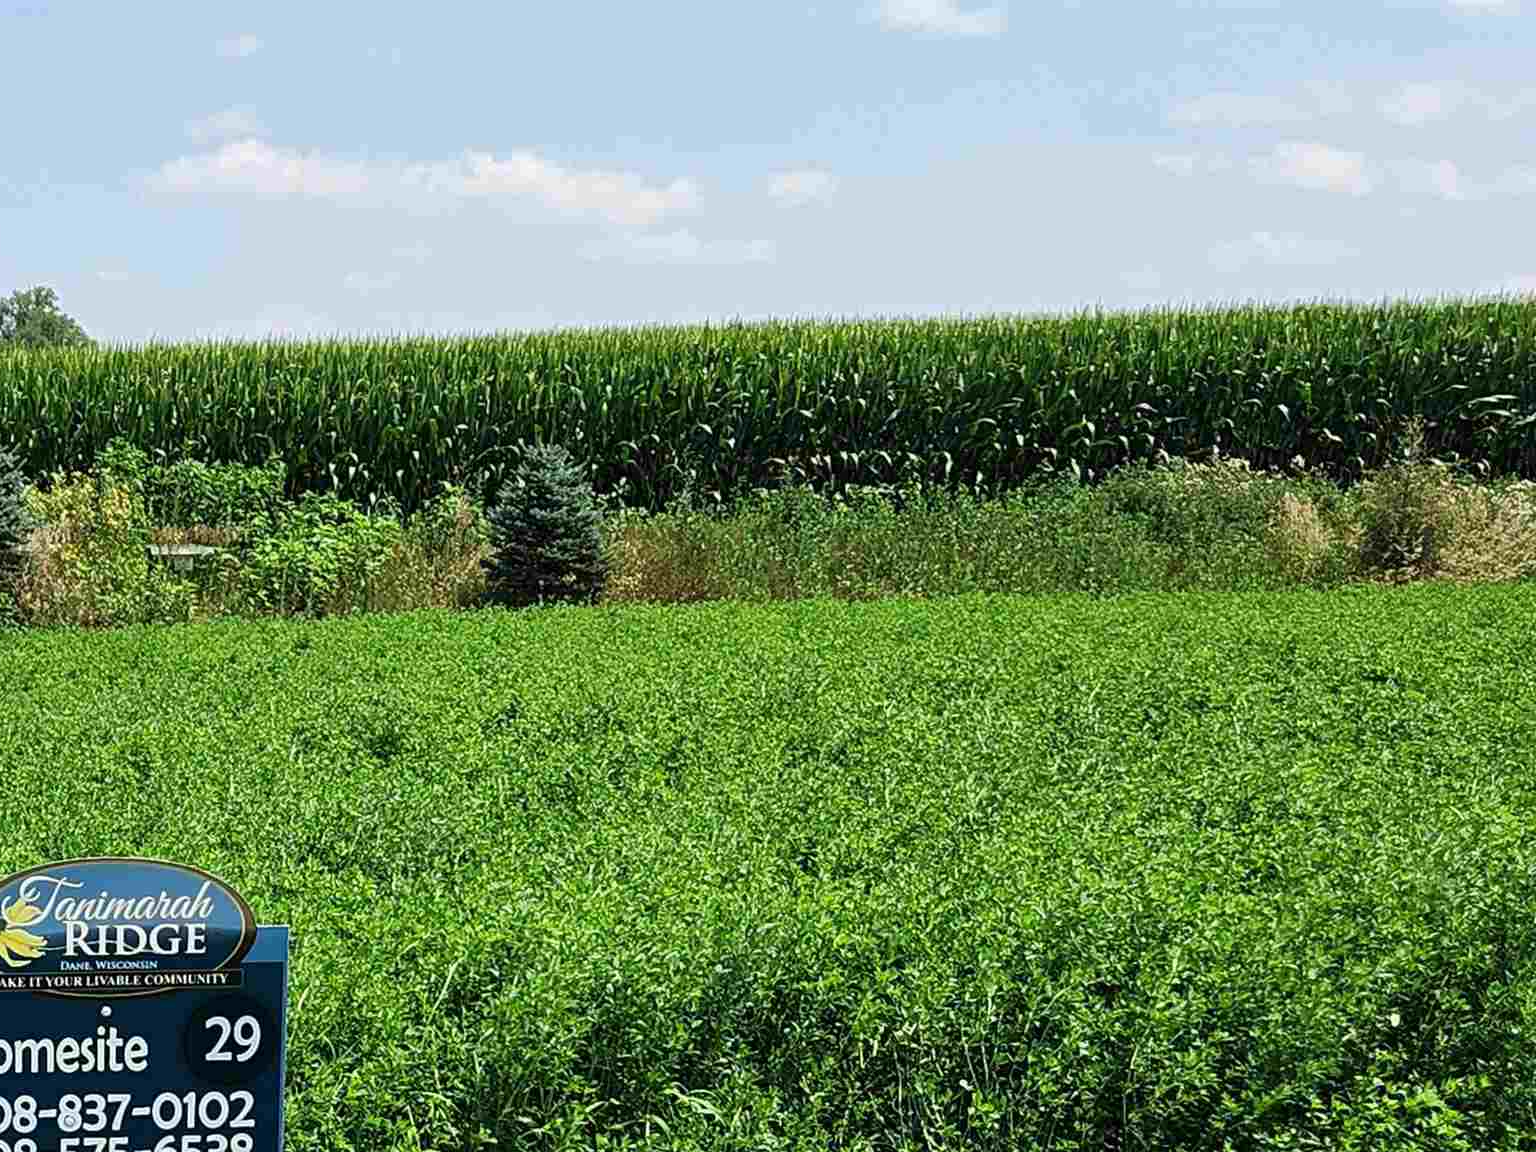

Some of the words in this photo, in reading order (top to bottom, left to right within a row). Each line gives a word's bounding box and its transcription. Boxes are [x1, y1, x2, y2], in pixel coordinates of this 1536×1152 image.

[1, 875, 214, 926] Tanimarah
[64, 920, 207, 957] RIDGE
[29, 977, 44, 988] IT
[45, 976, 83, 988] YOUR
[85, 975, 142, 987] LIVABLE
[144, 973, 229, 986] COMMUNITY
[95, 959, 158, 970] WISCONSIN
[204, 1014, 262, 1063] 29
